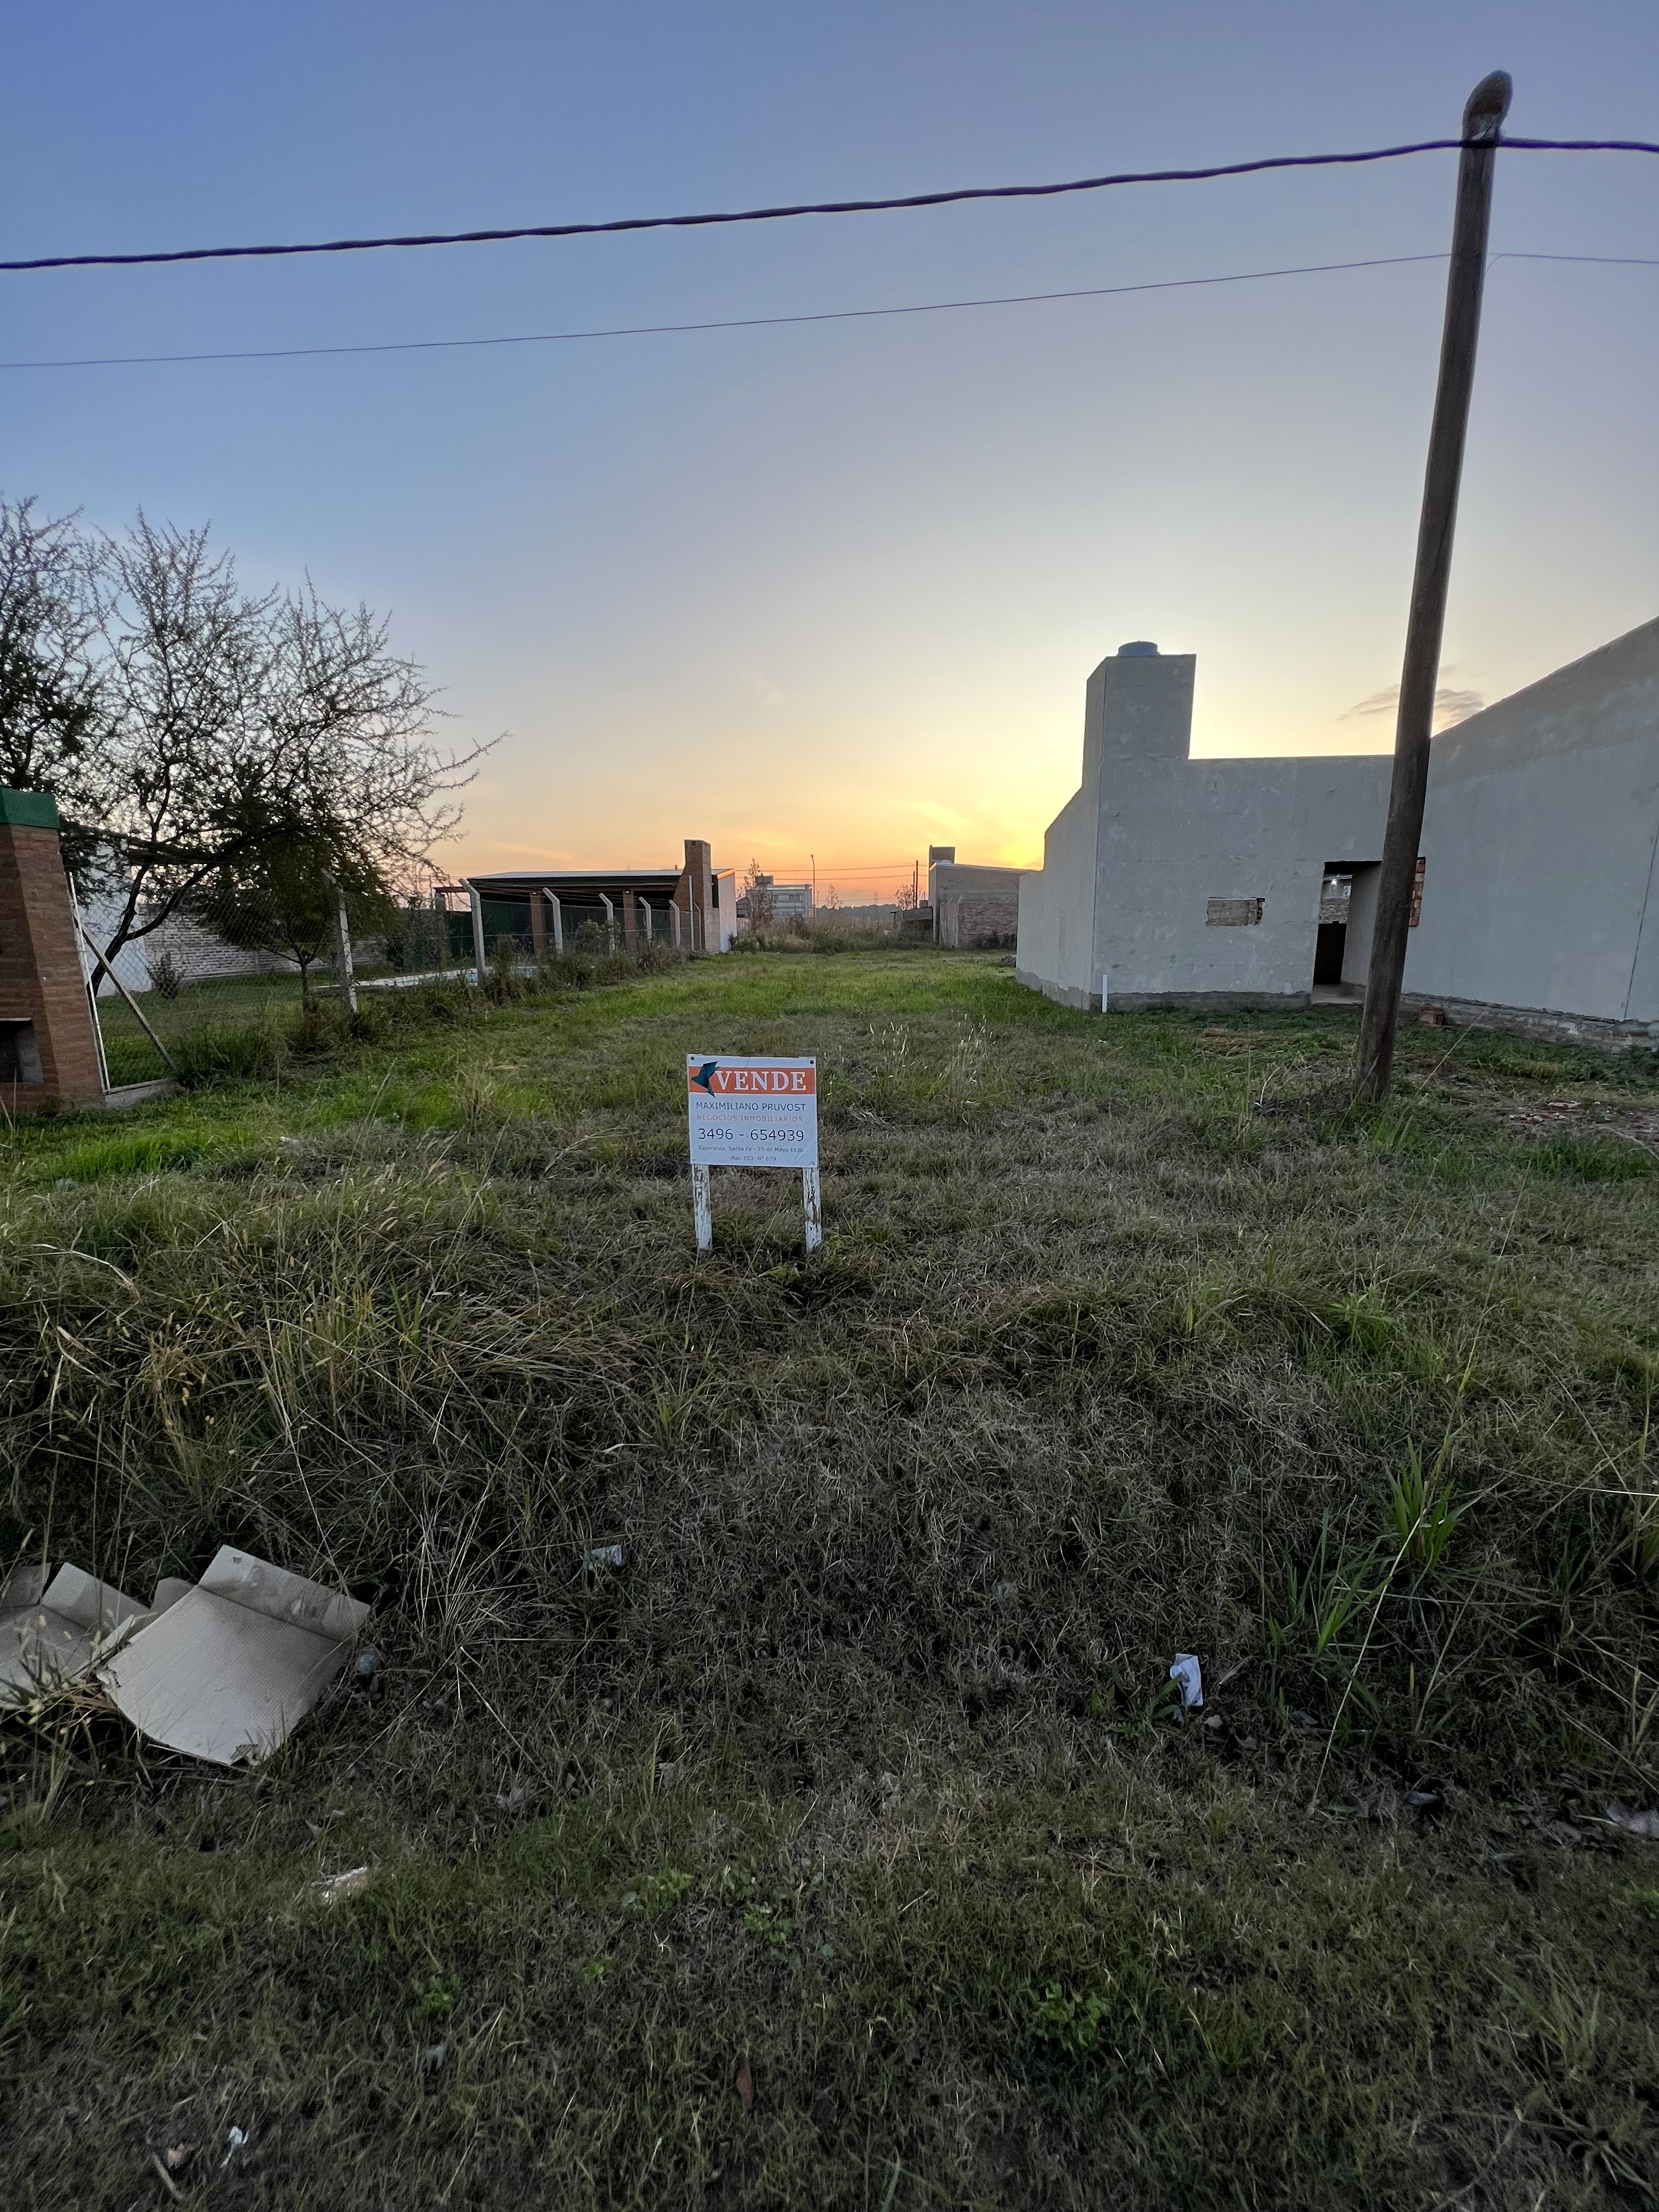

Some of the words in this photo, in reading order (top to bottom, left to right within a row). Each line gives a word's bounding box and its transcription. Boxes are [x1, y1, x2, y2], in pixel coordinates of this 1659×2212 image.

[715, 1070, 806, 1091] VENDE
[696, 1102, 758, 1110] MAXIMILIANO
[762, 1103, 806, 1111] PRUVOST
[698, 1128, 733, 1140] 3496
[751, 1128, 804, 1142] 654939
